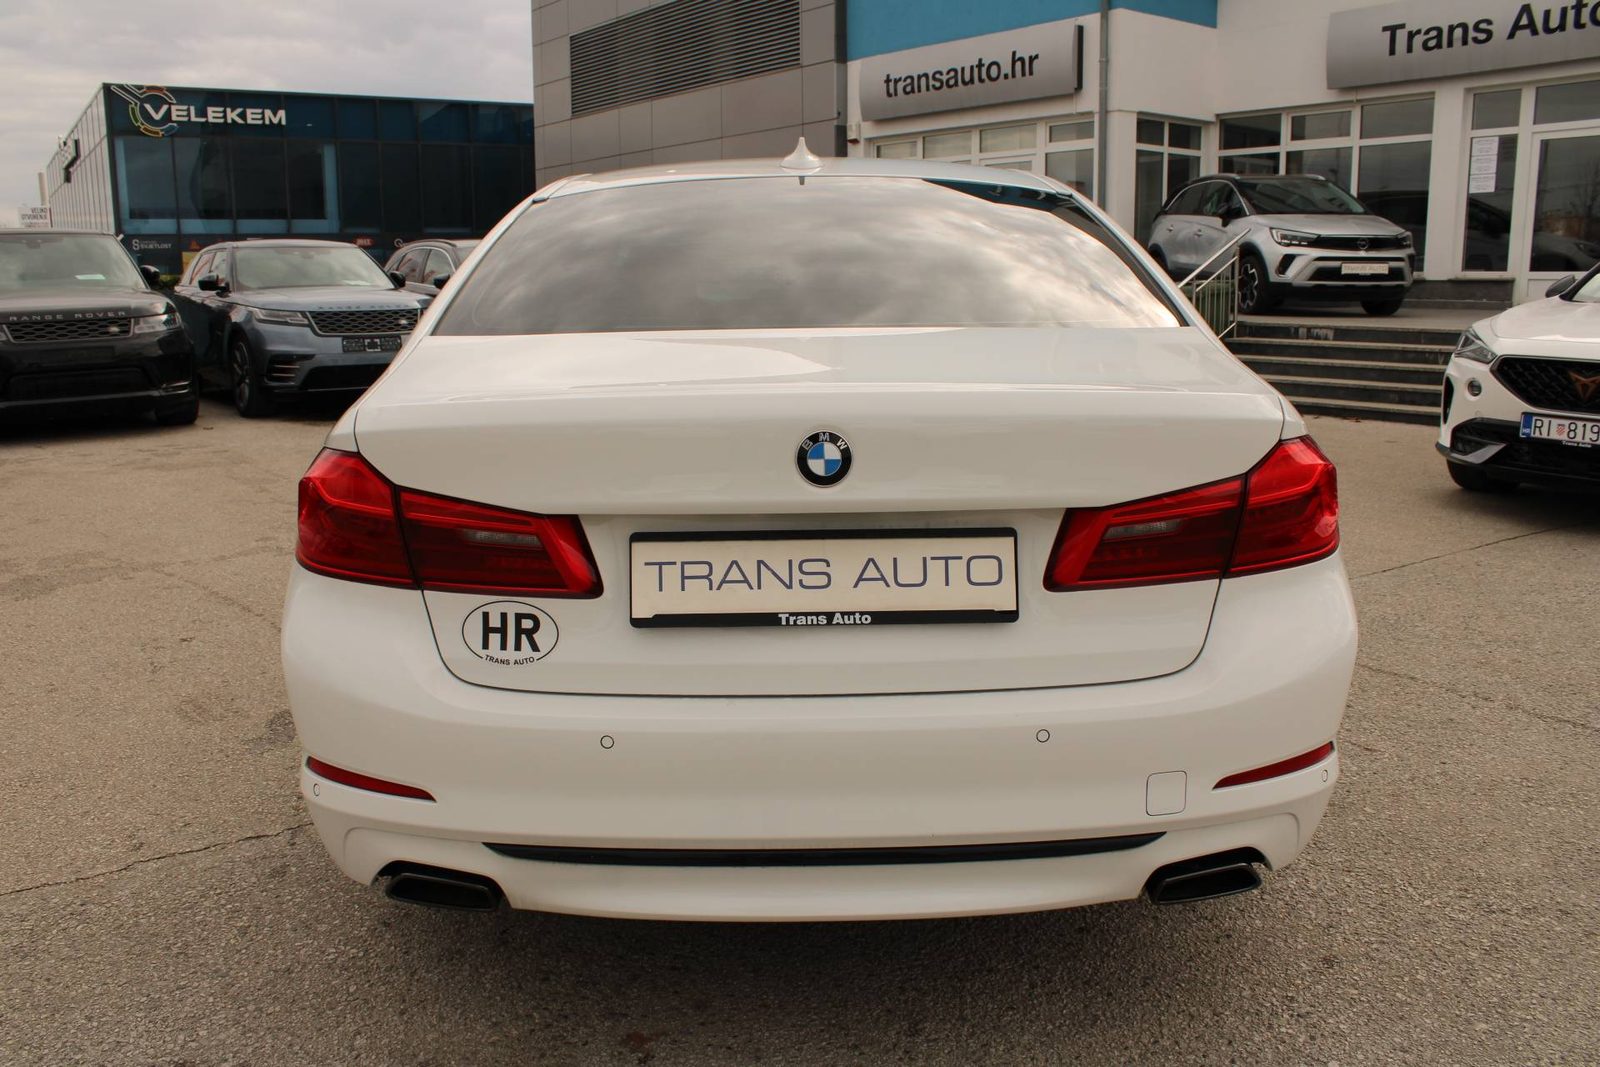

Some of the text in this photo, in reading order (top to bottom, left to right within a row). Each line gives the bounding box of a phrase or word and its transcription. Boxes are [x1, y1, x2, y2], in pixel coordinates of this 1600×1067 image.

[1381, 18, 1494, 56] Trans
[884, 50, 1039, 98] transauto.hr
[143, 103, 287, 126] VELEKEM
[802, 432, 847, 450] BMW
[1533, 418, 1600, 443] RI 819
[644, 555, 1003, 592] TRANS AUTO
[778, 612, 872, 625] Trans Auto
[482, 611, 541, 653] HR
[485, 654, 535, 666] TRANS AUTO
